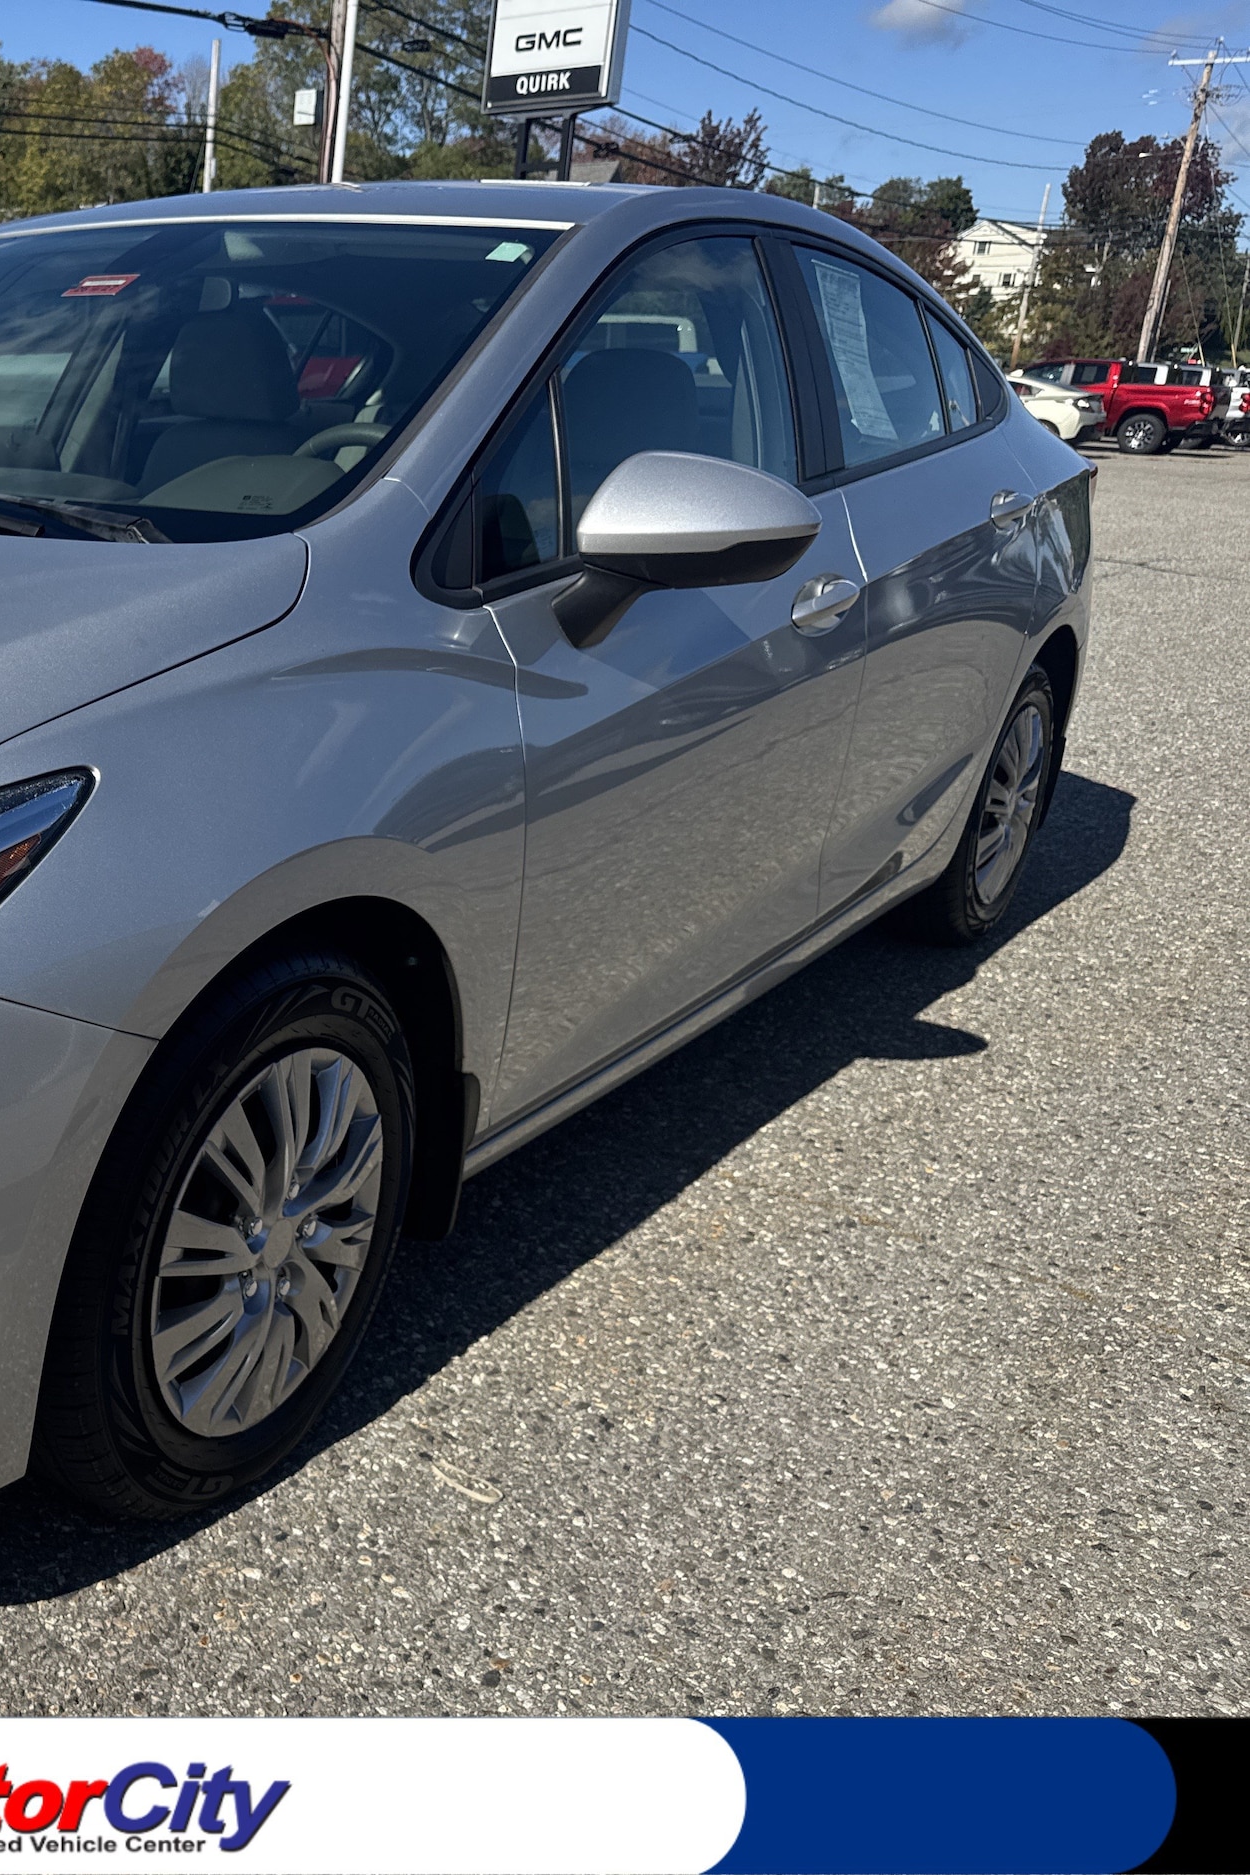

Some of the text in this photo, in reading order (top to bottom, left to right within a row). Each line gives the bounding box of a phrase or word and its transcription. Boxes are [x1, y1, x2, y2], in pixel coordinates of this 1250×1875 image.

[515, 27, 584, 53] GMC
[516, 71, 571, 95] QUIRK
[331, 985, 396, 1035] GT
